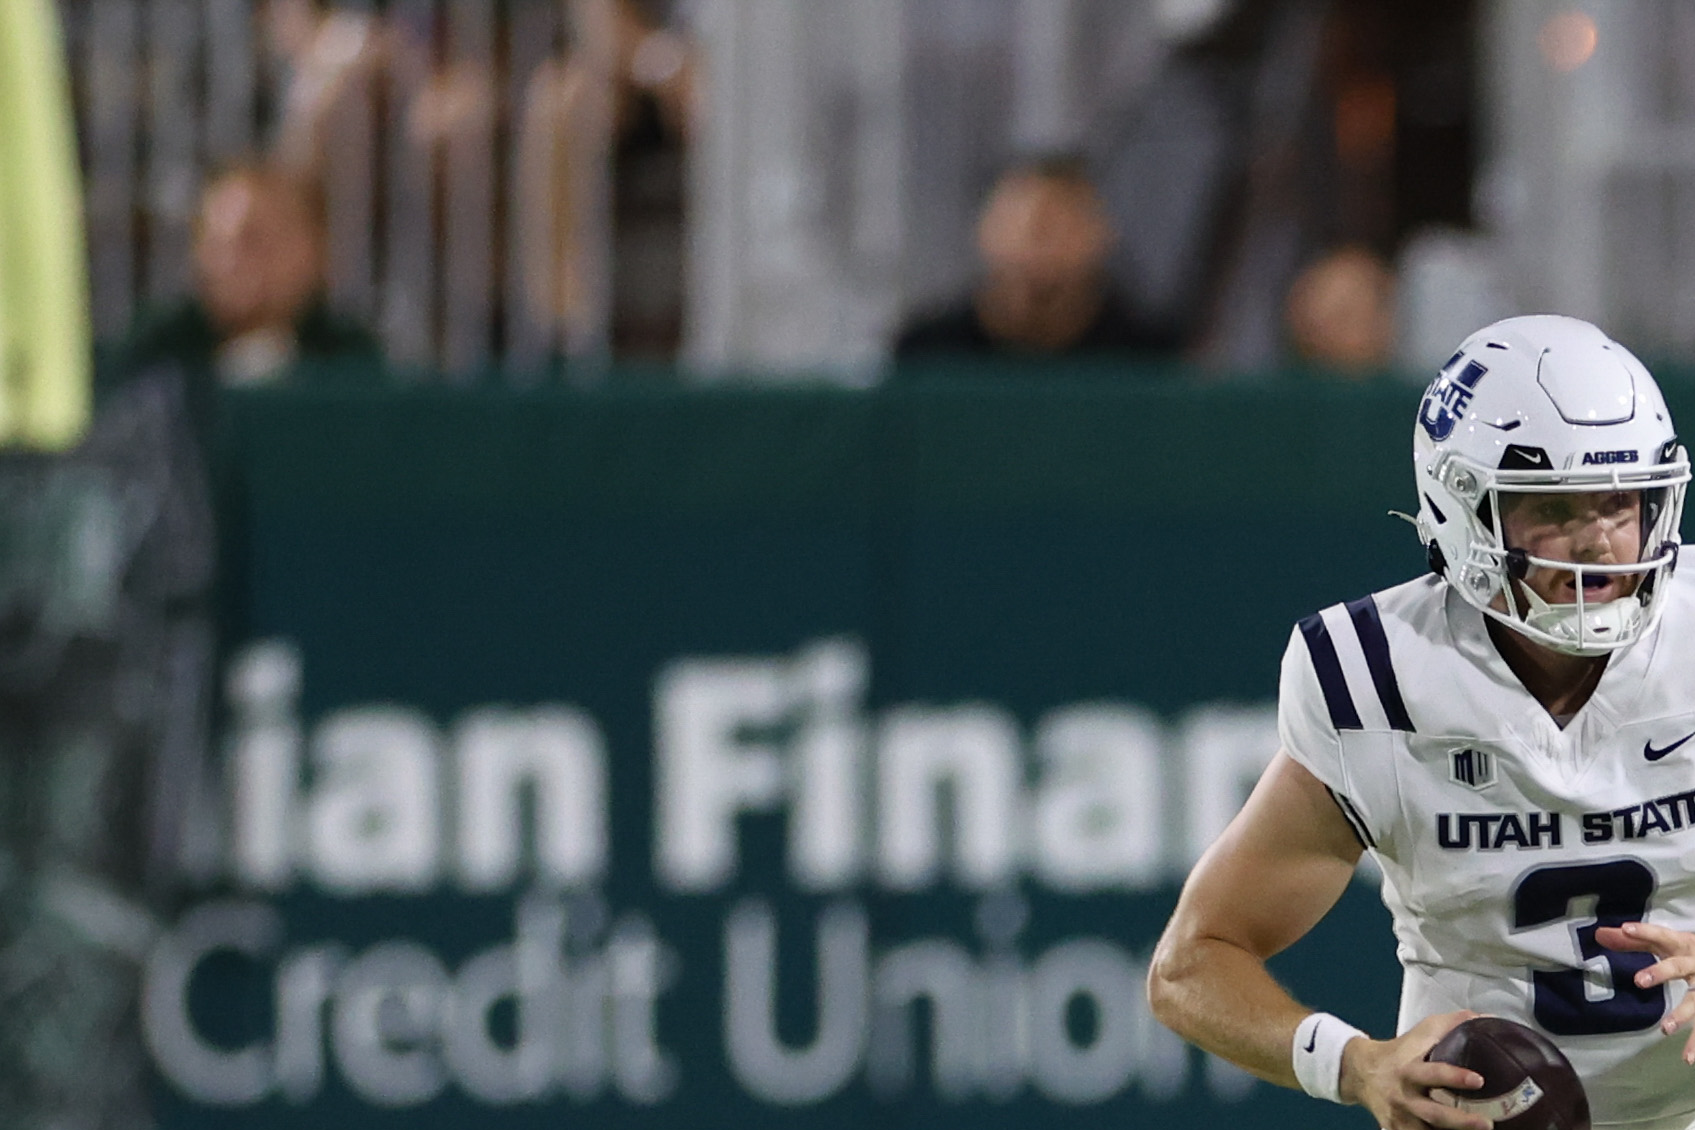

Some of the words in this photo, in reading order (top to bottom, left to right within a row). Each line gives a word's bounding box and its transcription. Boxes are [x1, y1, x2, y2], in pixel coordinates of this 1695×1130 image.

[1581, 449, 1639, 466] AGGIES
[1436, 812, 1562, 851] UTAH
[146, 895, 675, 1105] Credit
[1509, 854, 1667, 1037] 3
